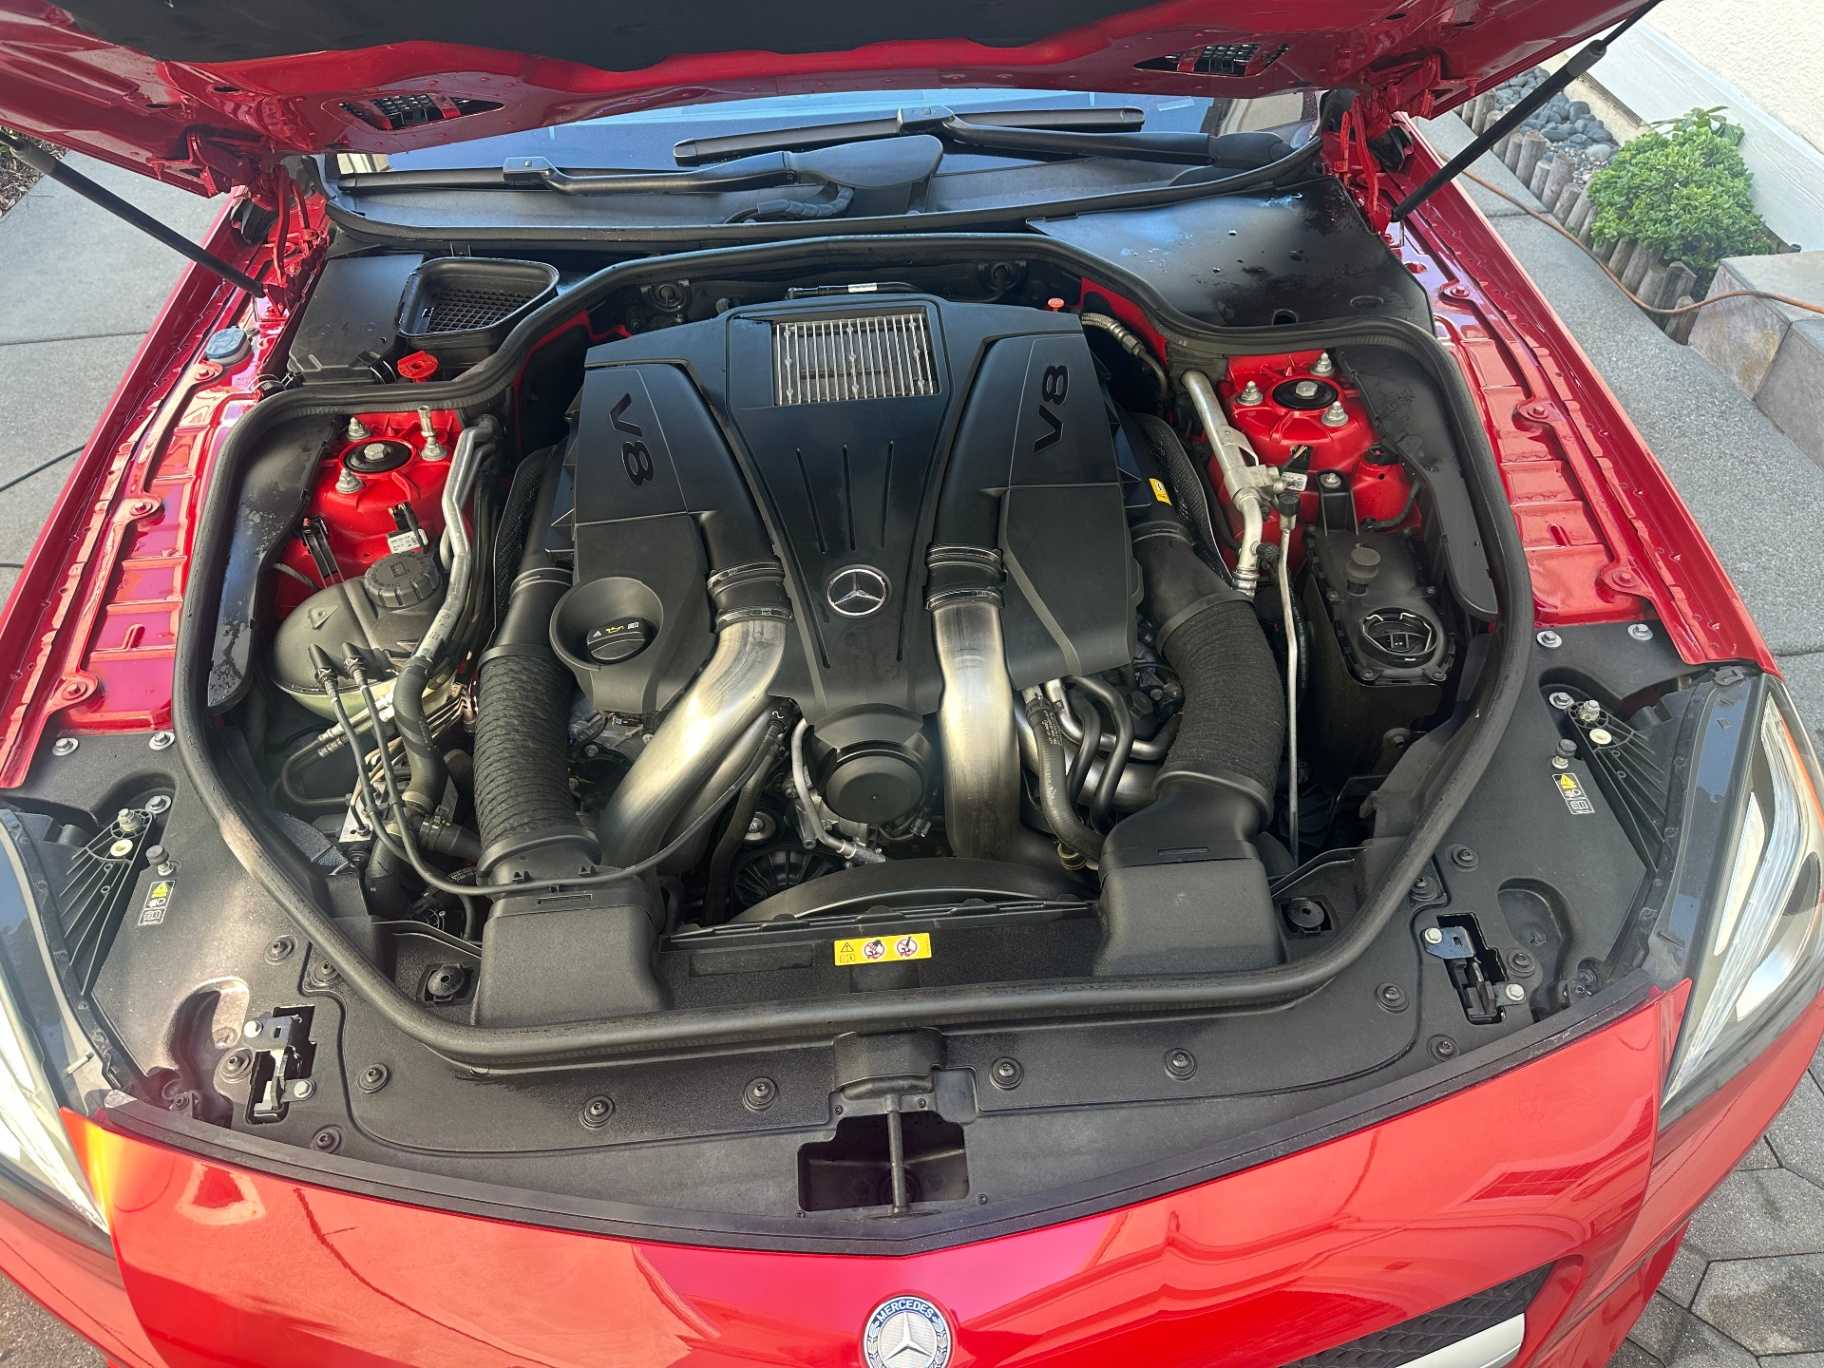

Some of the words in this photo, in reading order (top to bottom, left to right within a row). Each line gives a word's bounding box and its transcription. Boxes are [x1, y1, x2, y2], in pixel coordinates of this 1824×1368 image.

[609, 391, 655, 486] V8
[1033, 365, 1069, 453] V8
[876, 1299, 934, 1322] MERCEDES
